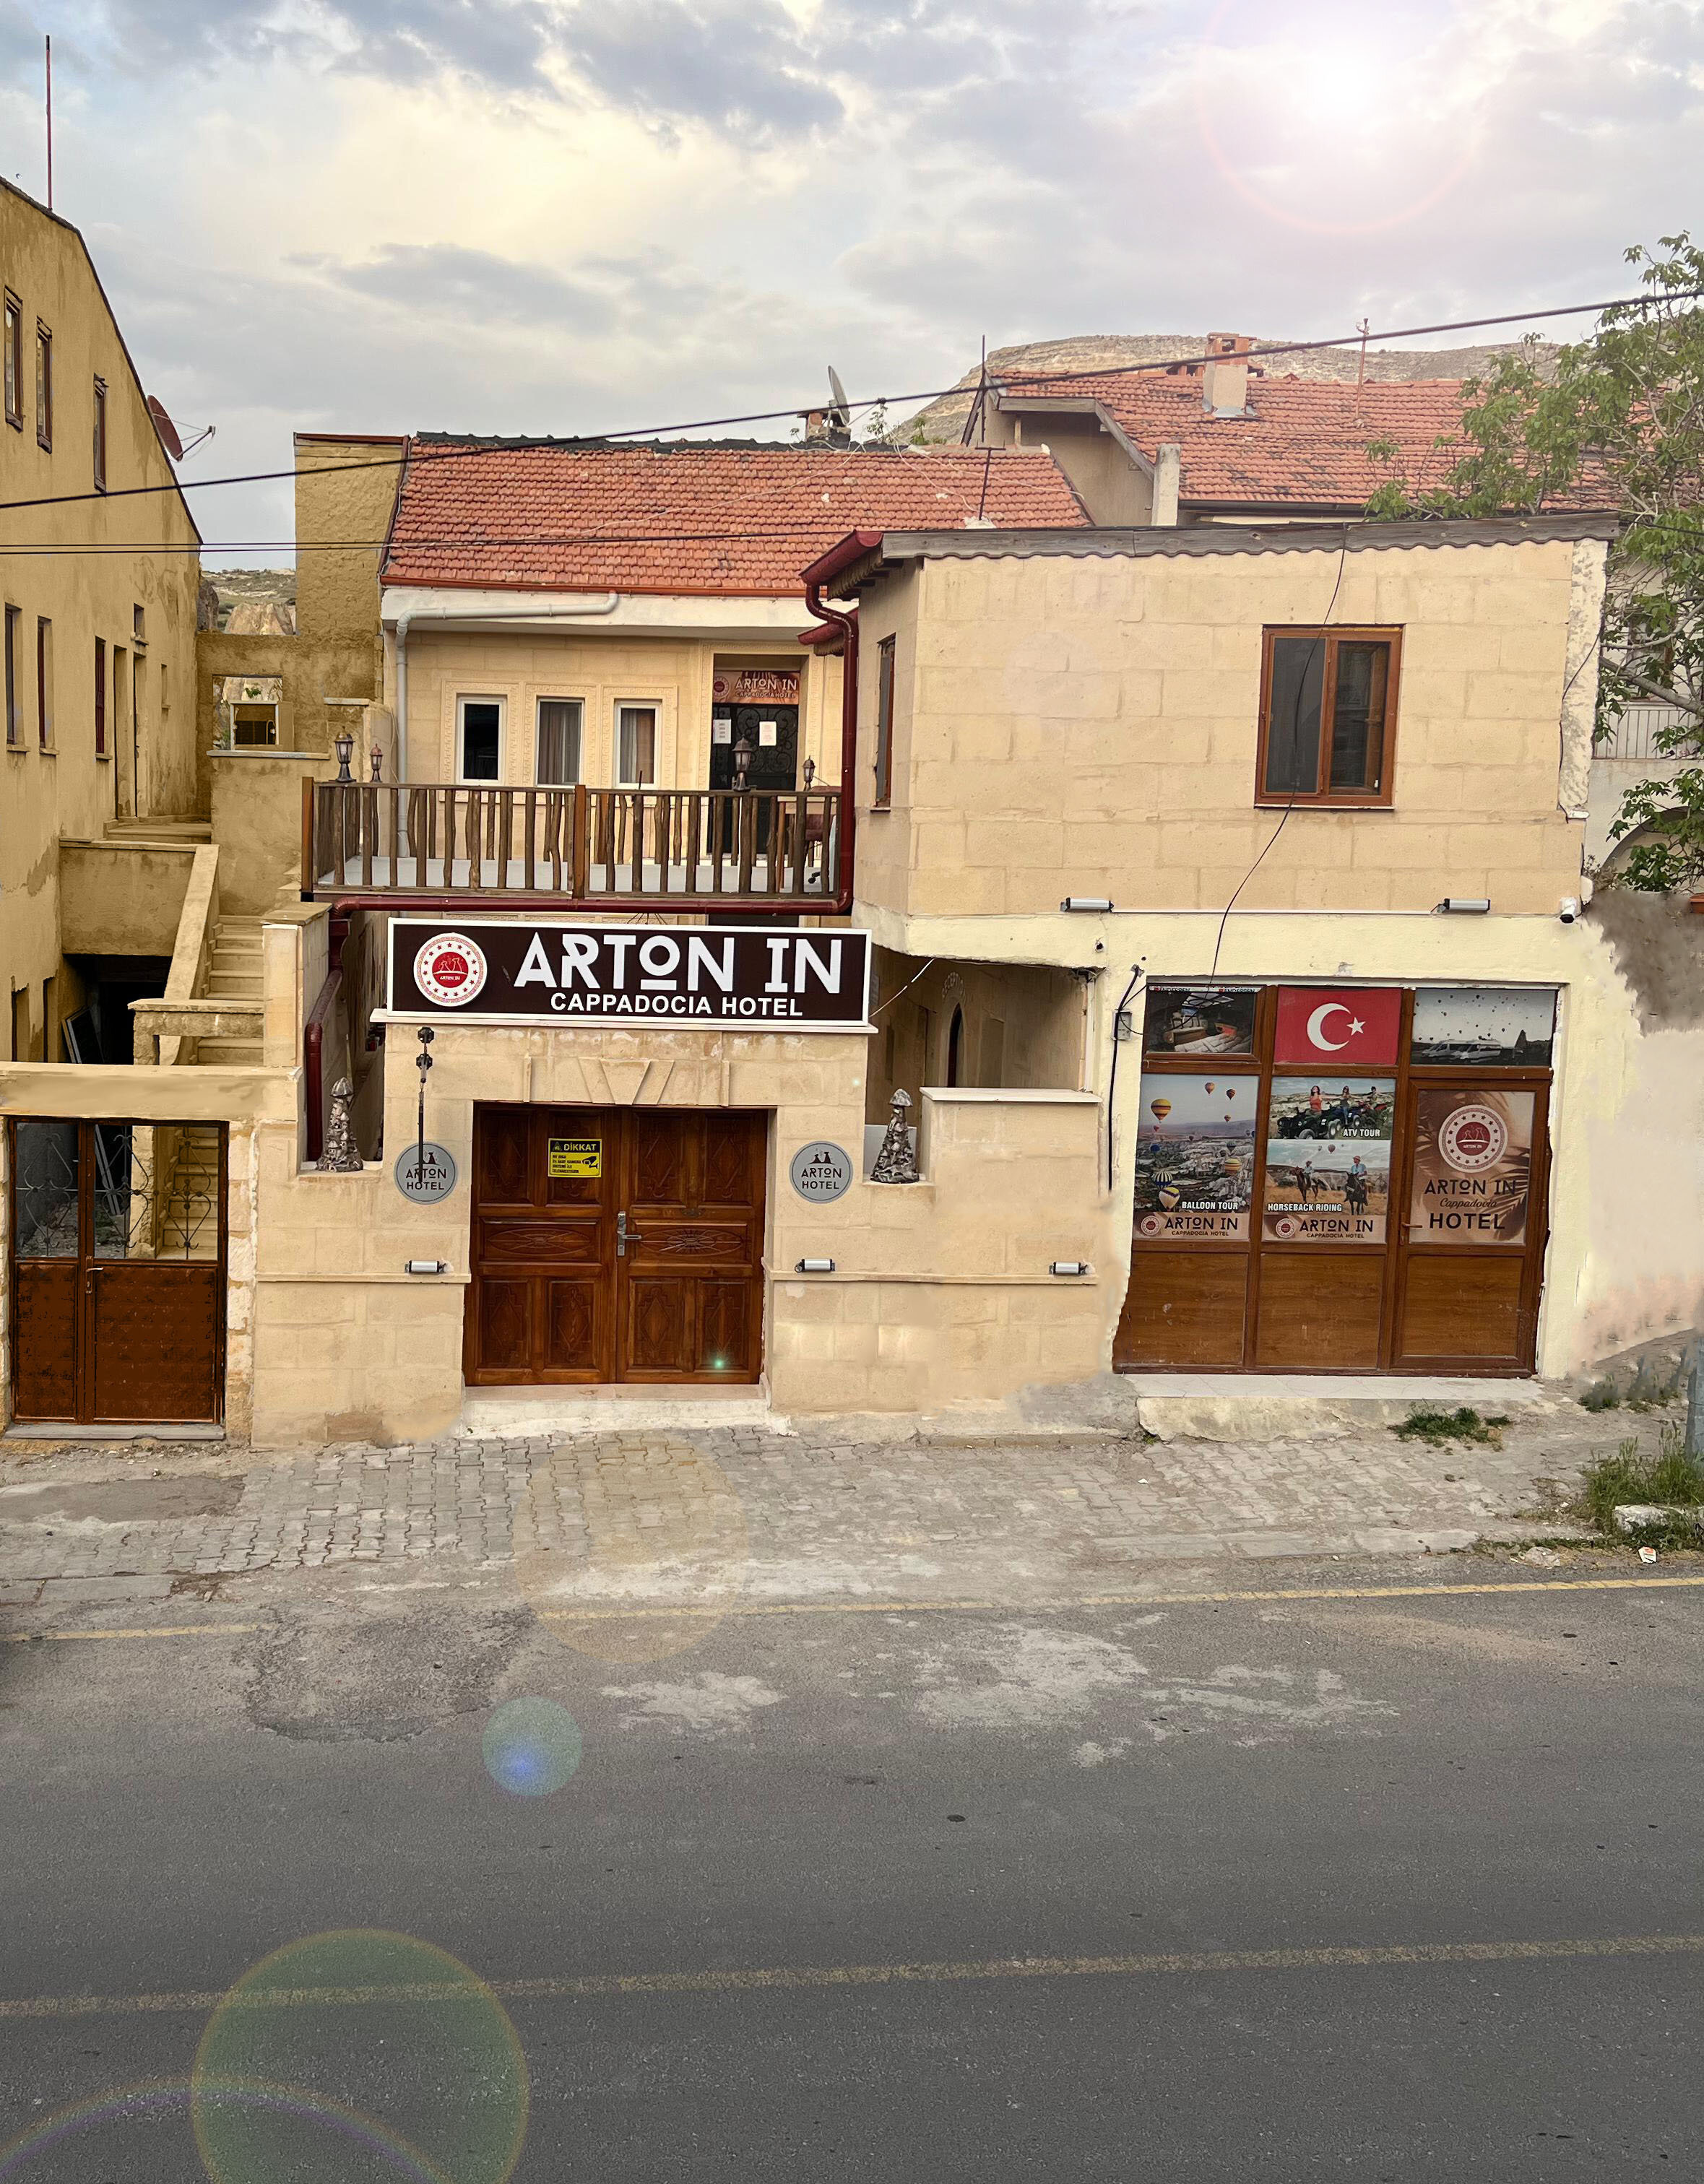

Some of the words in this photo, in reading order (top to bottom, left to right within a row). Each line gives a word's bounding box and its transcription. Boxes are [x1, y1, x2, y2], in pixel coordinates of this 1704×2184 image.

[735, 678, 777, 690] ARTON
[782, 679, 797, 690] IN
[514, 932, 735, 992] ARTON
[764, 937, 842, 994] IN
[550, 992, 712, 1015] CAPPADOCIA
[722, 997, 803, 1017] HOTEL
[1343, 1128, 1357, 1137] ATV
[1359, 1128, 1380, 1137] TOUR
[563, 1143, 597, 1151] DİKKAT
[801, 1167, 842, 1179] ARTON
[407, 1182, 445, 1190] HOTEL
[802, 1180, 839, 1190] HOTEL
[1424, 1179, 1486, 1195] ARTON
[1494, 1179, 1517, 1195] IN
[1181, 1201, 1216, 1210] BALLOON
[1218, 1201, 1239, 1210] TOUR
[1268, 1203, 1314, 1212] HORSEBACK
[1316, 1203, 1342, 1212] RIDING
[1440, 1197, 1497, 1210] Cappadocia
[1164, 1217, 1214, 1230] ARTON
[1220, 1218, 1238, 1231] IN
[1299, 1219, 1349, 1232] ARTON
[1356, 1220, 1374, 1232] IN
[1429, 1213, 1505, 1230] HOTEL
